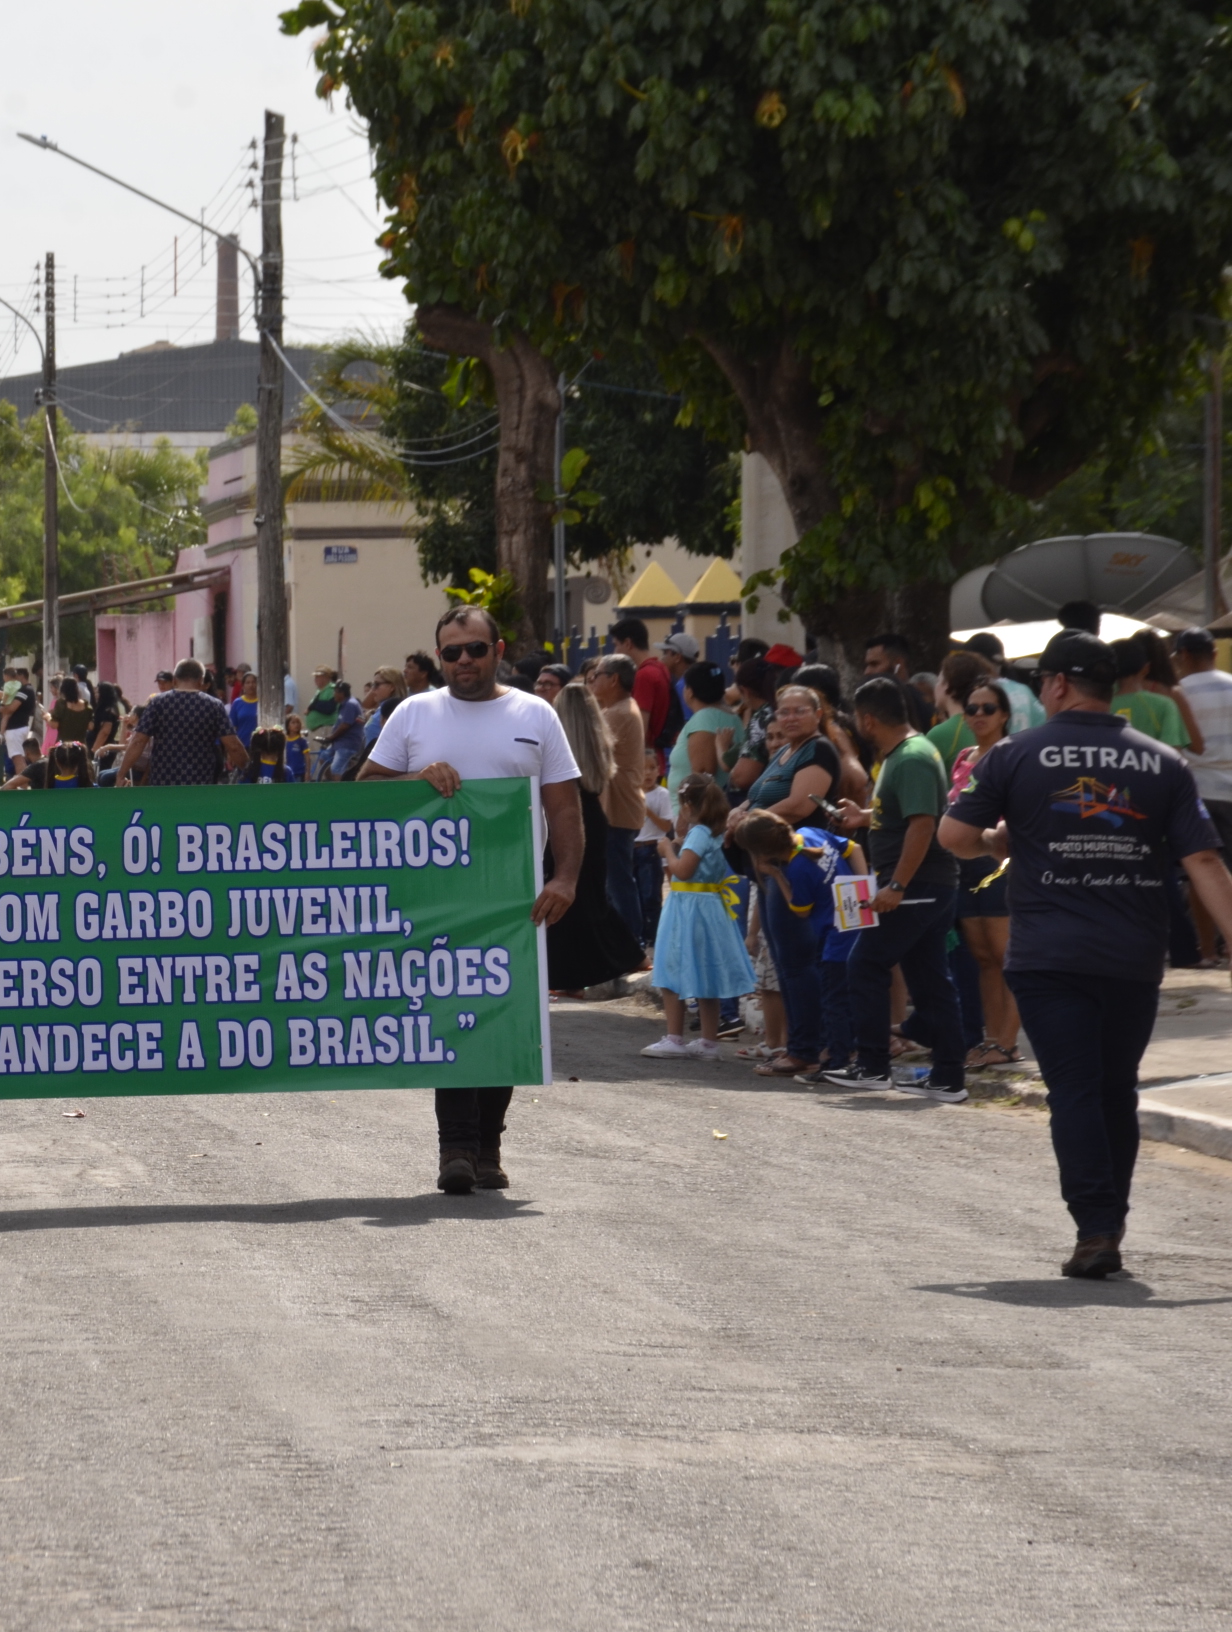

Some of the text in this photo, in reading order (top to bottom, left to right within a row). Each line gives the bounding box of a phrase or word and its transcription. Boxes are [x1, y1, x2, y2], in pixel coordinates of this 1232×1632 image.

[1039, 745, 1161, 774] GETRAN
[123, 811, 161, 875] Ó!
[176, 817, 470, 873] BRASILEIROS!
[1048, 842, 1081, 852] PORTO
[1041, 870, 1054, 885] O
[75, 889, 212, 940] GARBO
[227, 886, 413, 938] JUVENIL,
[118, 954, 261, 1005] ENTRE
[275, 951, 328, 1001] AS
[343, 936, 511, 1011] NAÇÕES
[177, 1021, 205, 1069] A
[218, 1018, 273, 1068] DO
